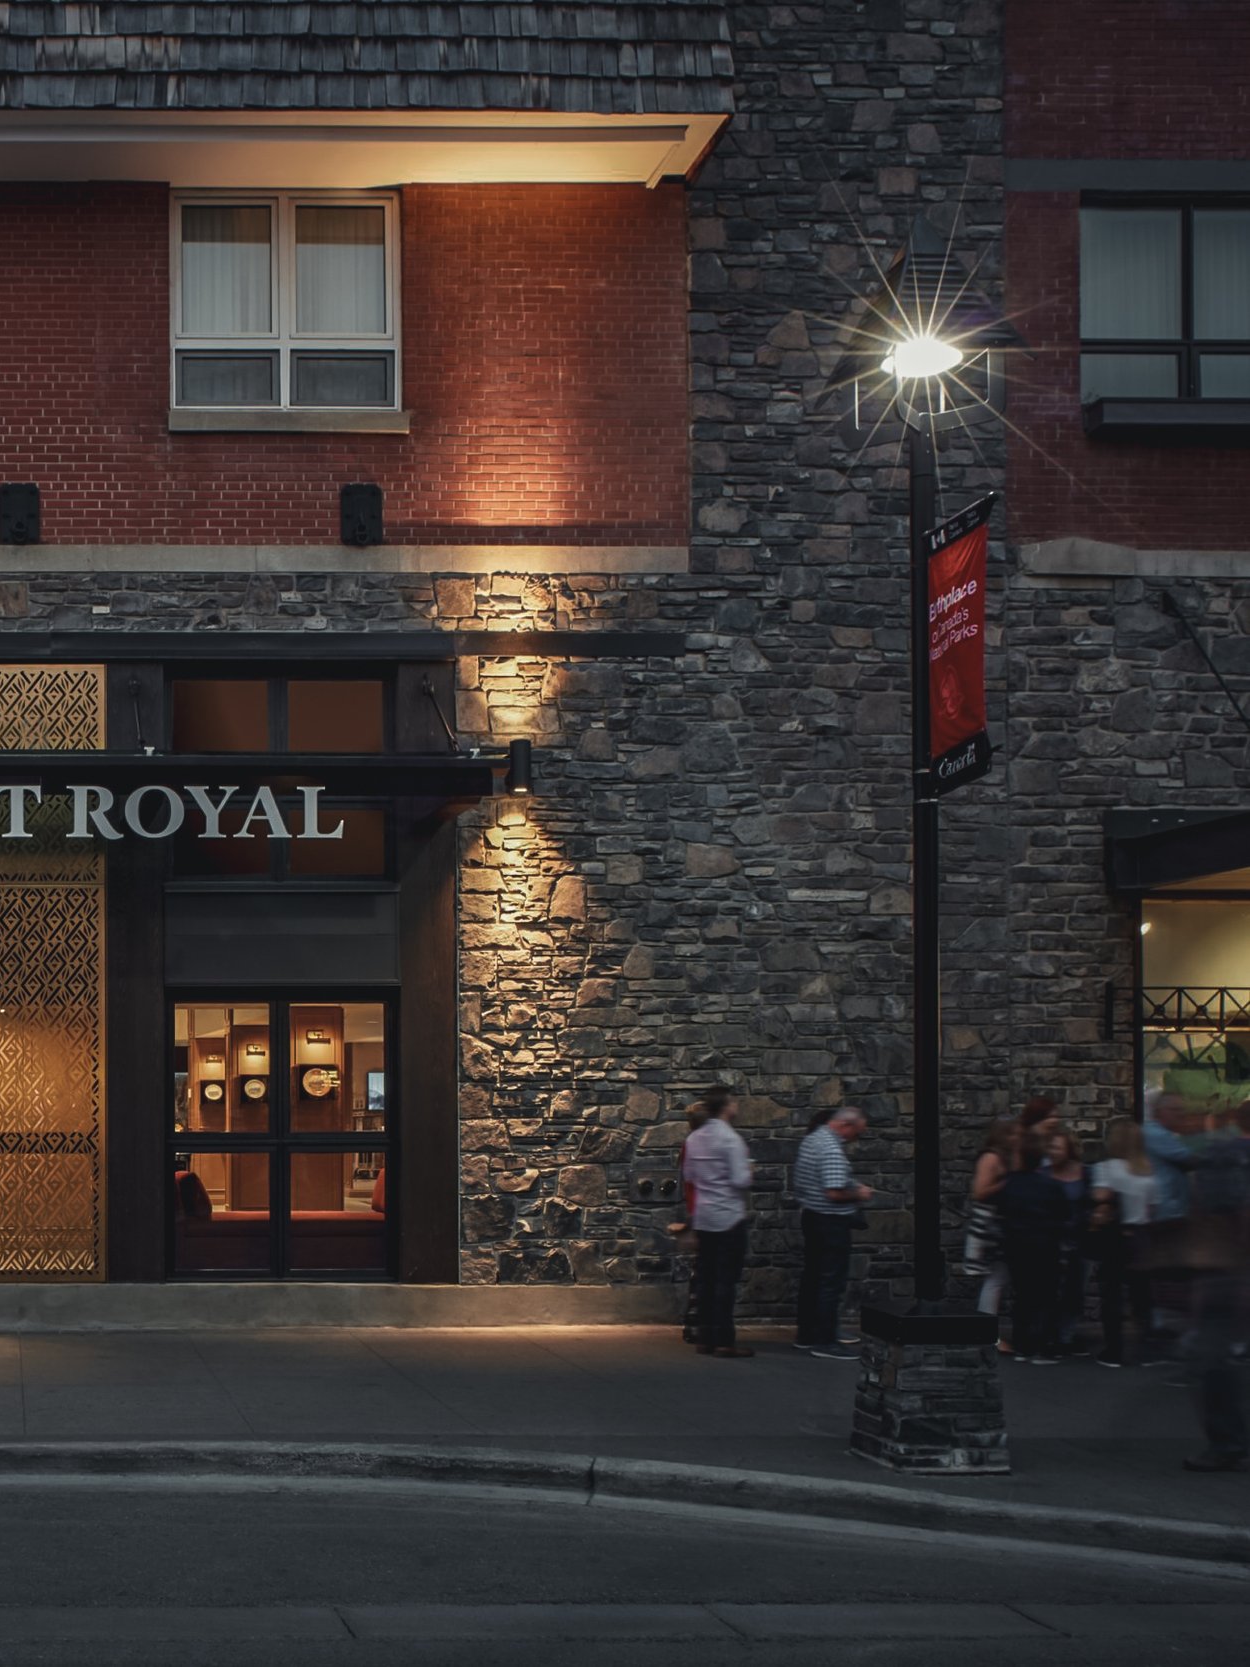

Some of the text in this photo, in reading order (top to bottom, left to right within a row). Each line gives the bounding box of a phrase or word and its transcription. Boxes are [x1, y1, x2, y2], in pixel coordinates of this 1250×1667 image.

[929, 579, 977, 622] Bthplace
[950, 624, 978, 645] Parks
[65, 783, 345, 840] ROYAL
